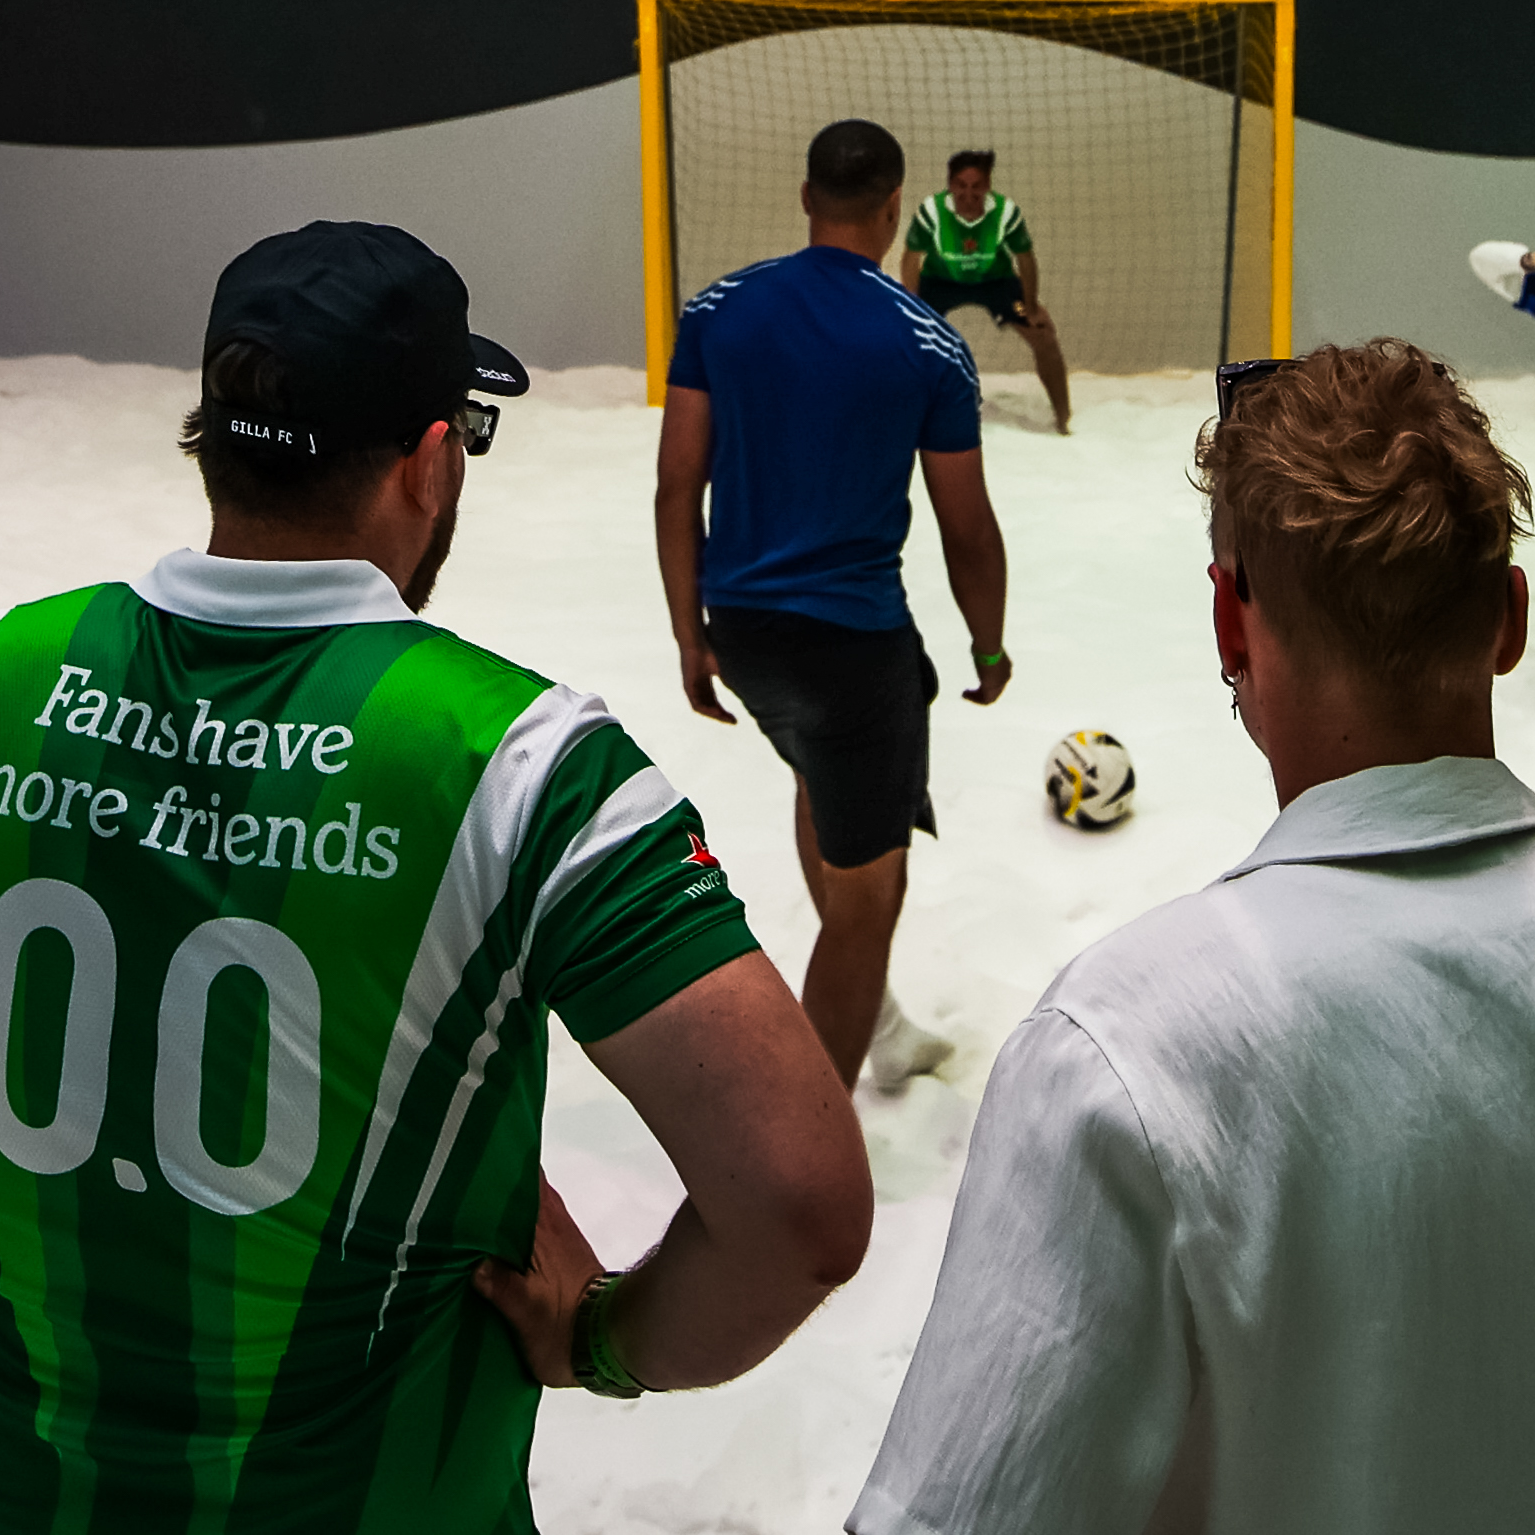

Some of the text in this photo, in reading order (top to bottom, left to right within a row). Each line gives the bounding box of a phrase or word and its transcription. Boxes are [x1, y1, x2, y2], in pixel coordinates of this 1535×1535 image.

[230, 419, 293, 445] GILLA FC
[185, 698, 355, 775] have
[138, 785, 401, 879] friends
